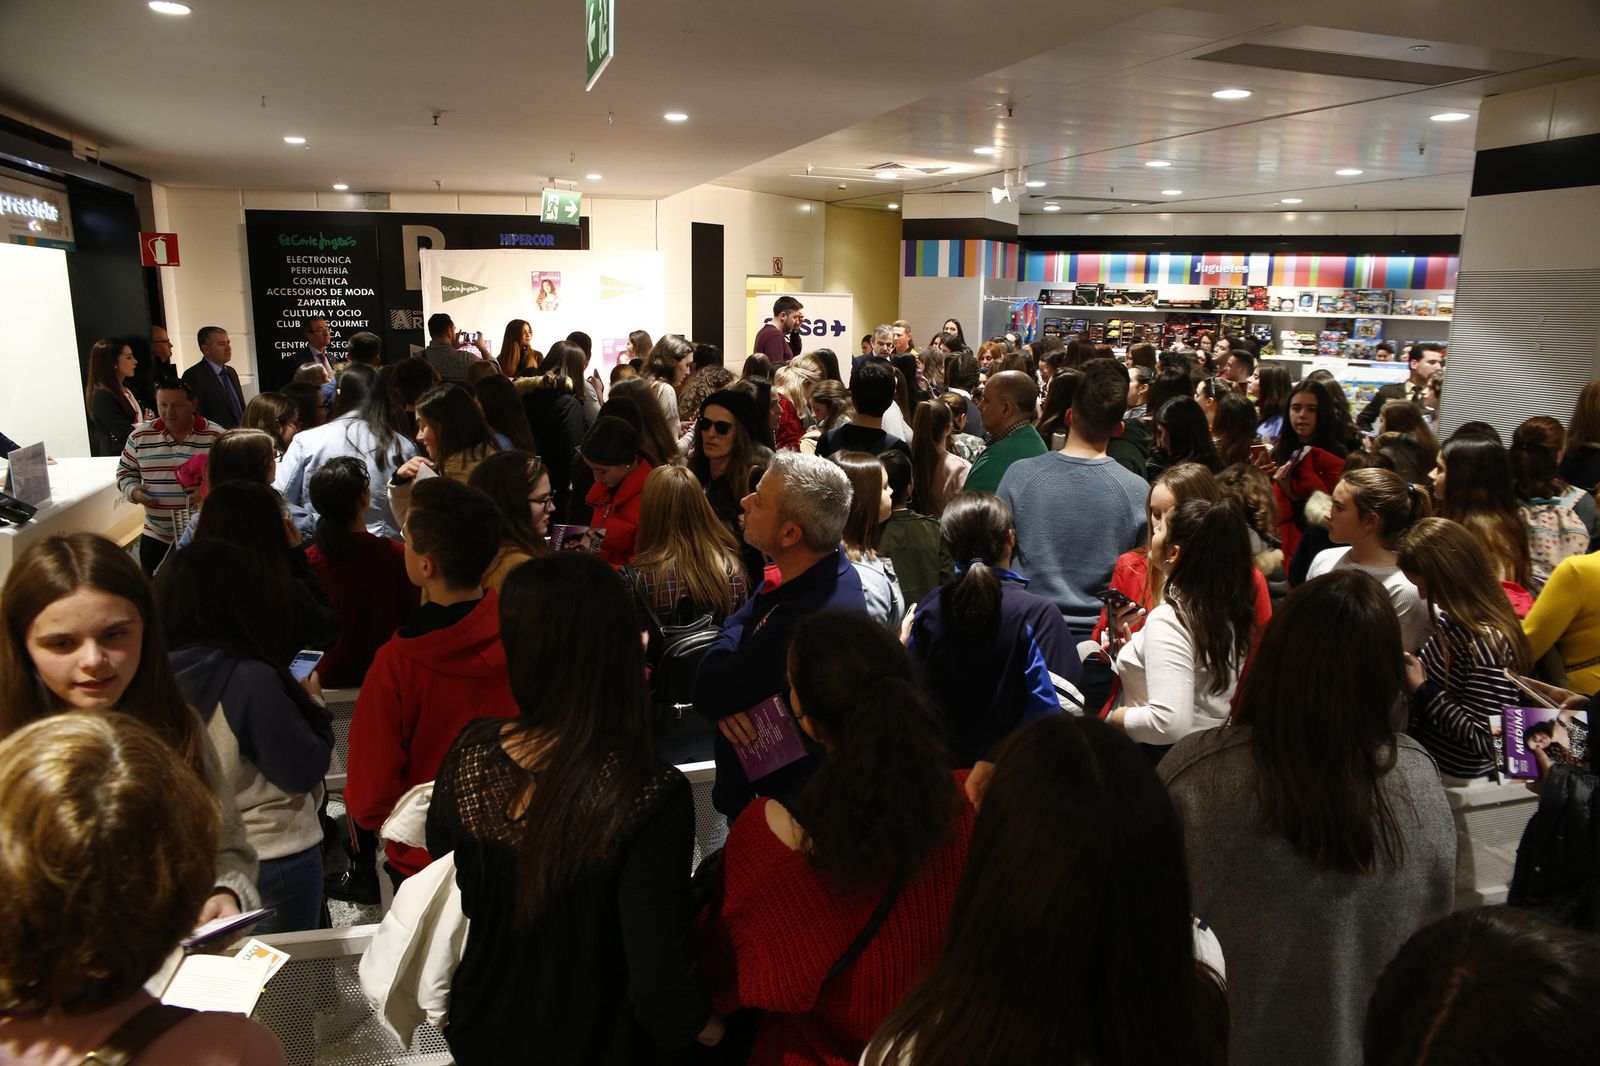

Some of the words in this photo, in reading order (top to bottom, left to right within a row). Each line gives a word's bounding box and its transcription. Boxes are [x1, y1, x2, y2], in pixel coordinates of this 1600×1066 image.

[279, 234, 290, 246] El
[291, 234, 318, 247] Corte
[319, 232, 357, 250] Inglés
[500, 234, 554, 247] HIPERCOR
[286, 254, 352, 264] ELECTRÓNICA
[291, 265, 349, 275] PERFUMERÍA
[1194, 262, 1250, 275] Juguetes
[293, 276, 348, 286] COSMÉTICA
[267, 288, 328, 296] ACCESORIOS
[330, 288, 343, 296] DE
[345, 288, 375, 296] MODA
[297, 297, 347, 307] ZAPATERÍA
[282, 309, 325, 318] CULTURA
[328, 309, 335, 318] Y
[336, 309, 362, 318] OCIO
[276, 320, 301, 328] CLUB
[1514, 709, 1525, 755] MEDINA
